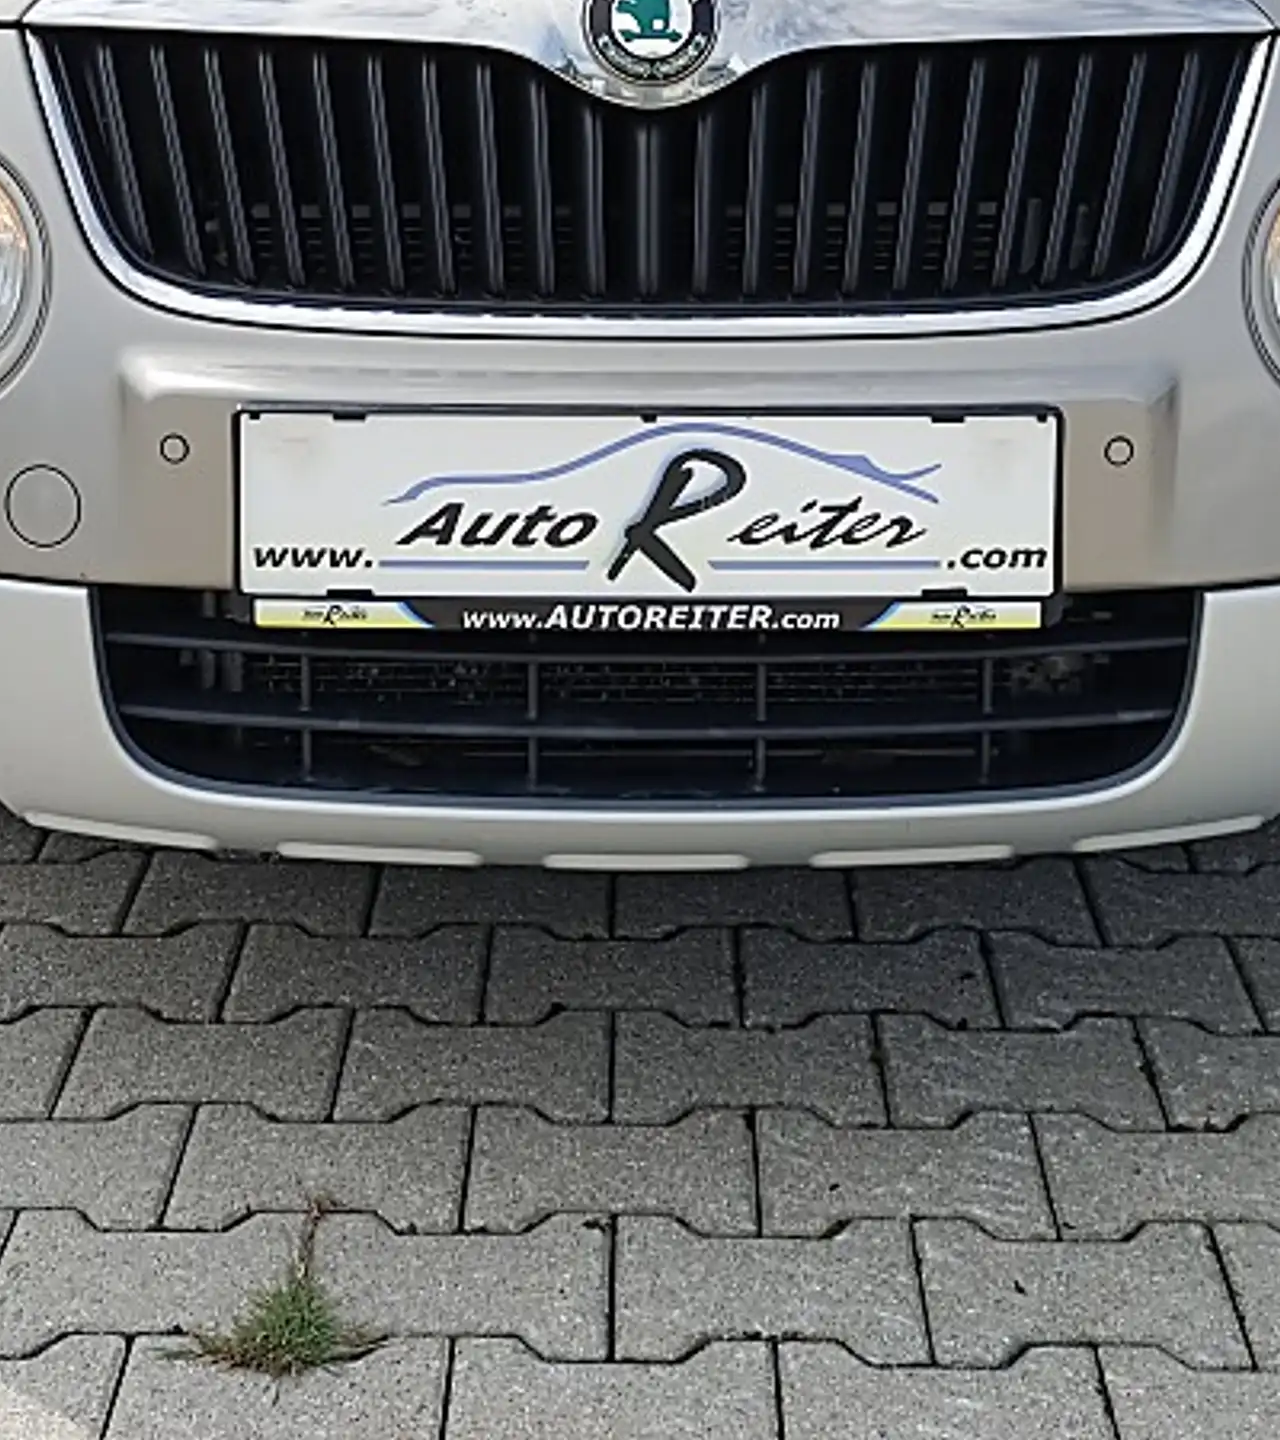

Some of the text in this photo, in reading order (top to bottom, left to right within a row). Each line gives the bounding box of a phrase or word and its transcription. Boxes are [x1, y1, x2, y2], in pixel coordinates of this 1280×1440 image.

[253, 546, 375, 569] www.
[396, 502, 600, 547] Auto
[945, 546, 1048, 570] .com
[462, 604, 841, 630] www.AUTOREITER.com
